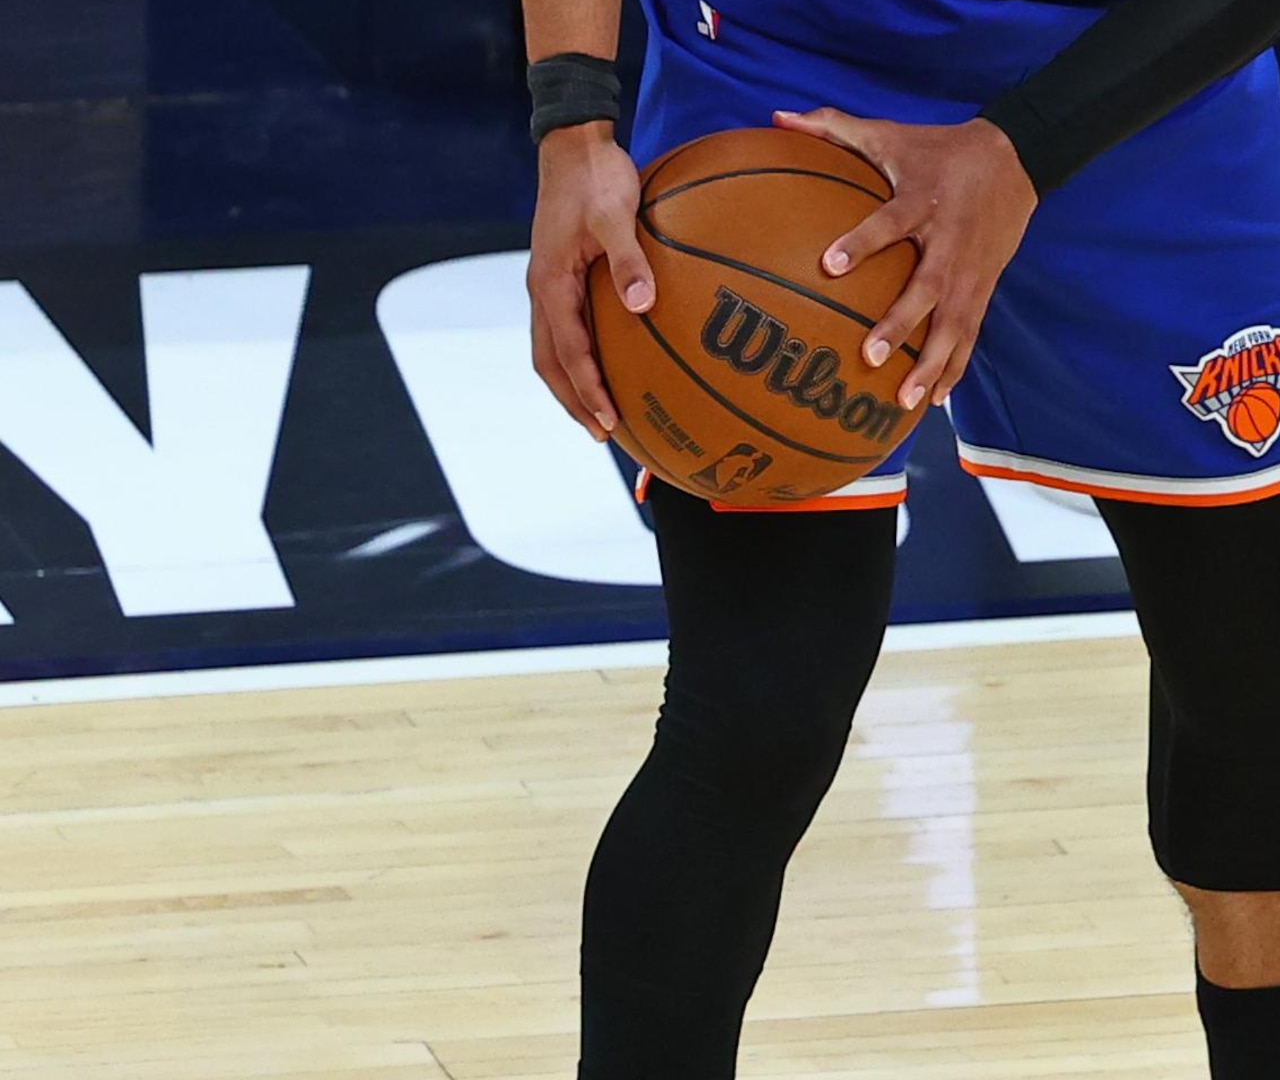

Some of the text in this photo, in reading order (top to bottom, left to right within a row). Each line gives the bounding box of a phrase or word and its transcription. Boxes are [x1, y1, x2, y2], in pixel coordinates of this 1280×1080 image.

[700, 285, 902, 444] Wilson
[1227, 329, 1272, 357] NEW YORK
